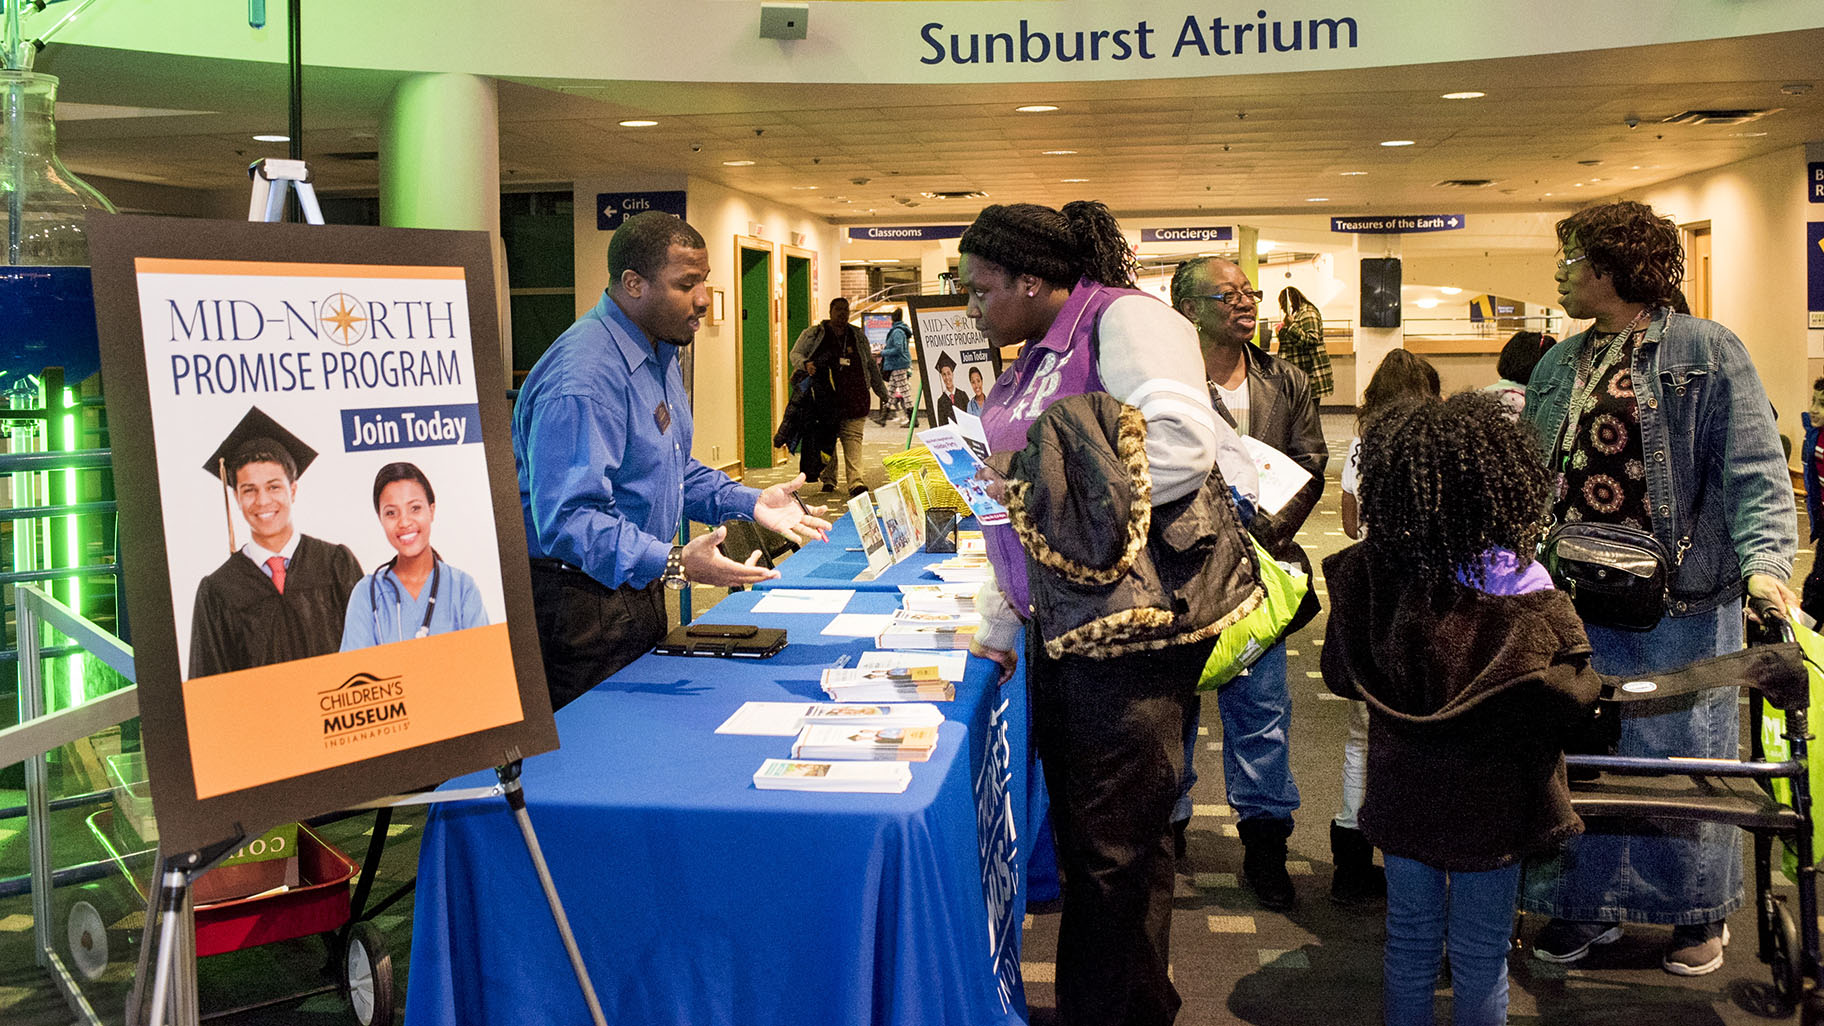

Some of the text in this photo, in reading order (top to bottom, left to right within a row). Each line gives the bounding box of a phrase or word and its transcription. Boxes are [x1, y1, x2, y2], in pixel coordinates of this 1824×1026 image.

[919, 9, 1358, 65] Sunburst Atrium
[622, 198, 650, 210] Girls
[868, 228, 922, 237] Classrooms
[1335, 217, 1444, 230] Treasures of the Earth
[1155, 228, 1218, 241] Concierge
[923, 315, 977, 333] MID-NORT
[925, 333, 954, 348] PROMISE
[962, 351, 988, 363] Join Today
[171, 350, 461, 396] PROMISE PROGRAM
[352, 410, 466, 446] Join Today
[320, 681, 403, 711] CHILDREN'S
[324, 702, 407, 734] MUSEUM
[324, 722, 409, 749] INDIANAPOLIS
